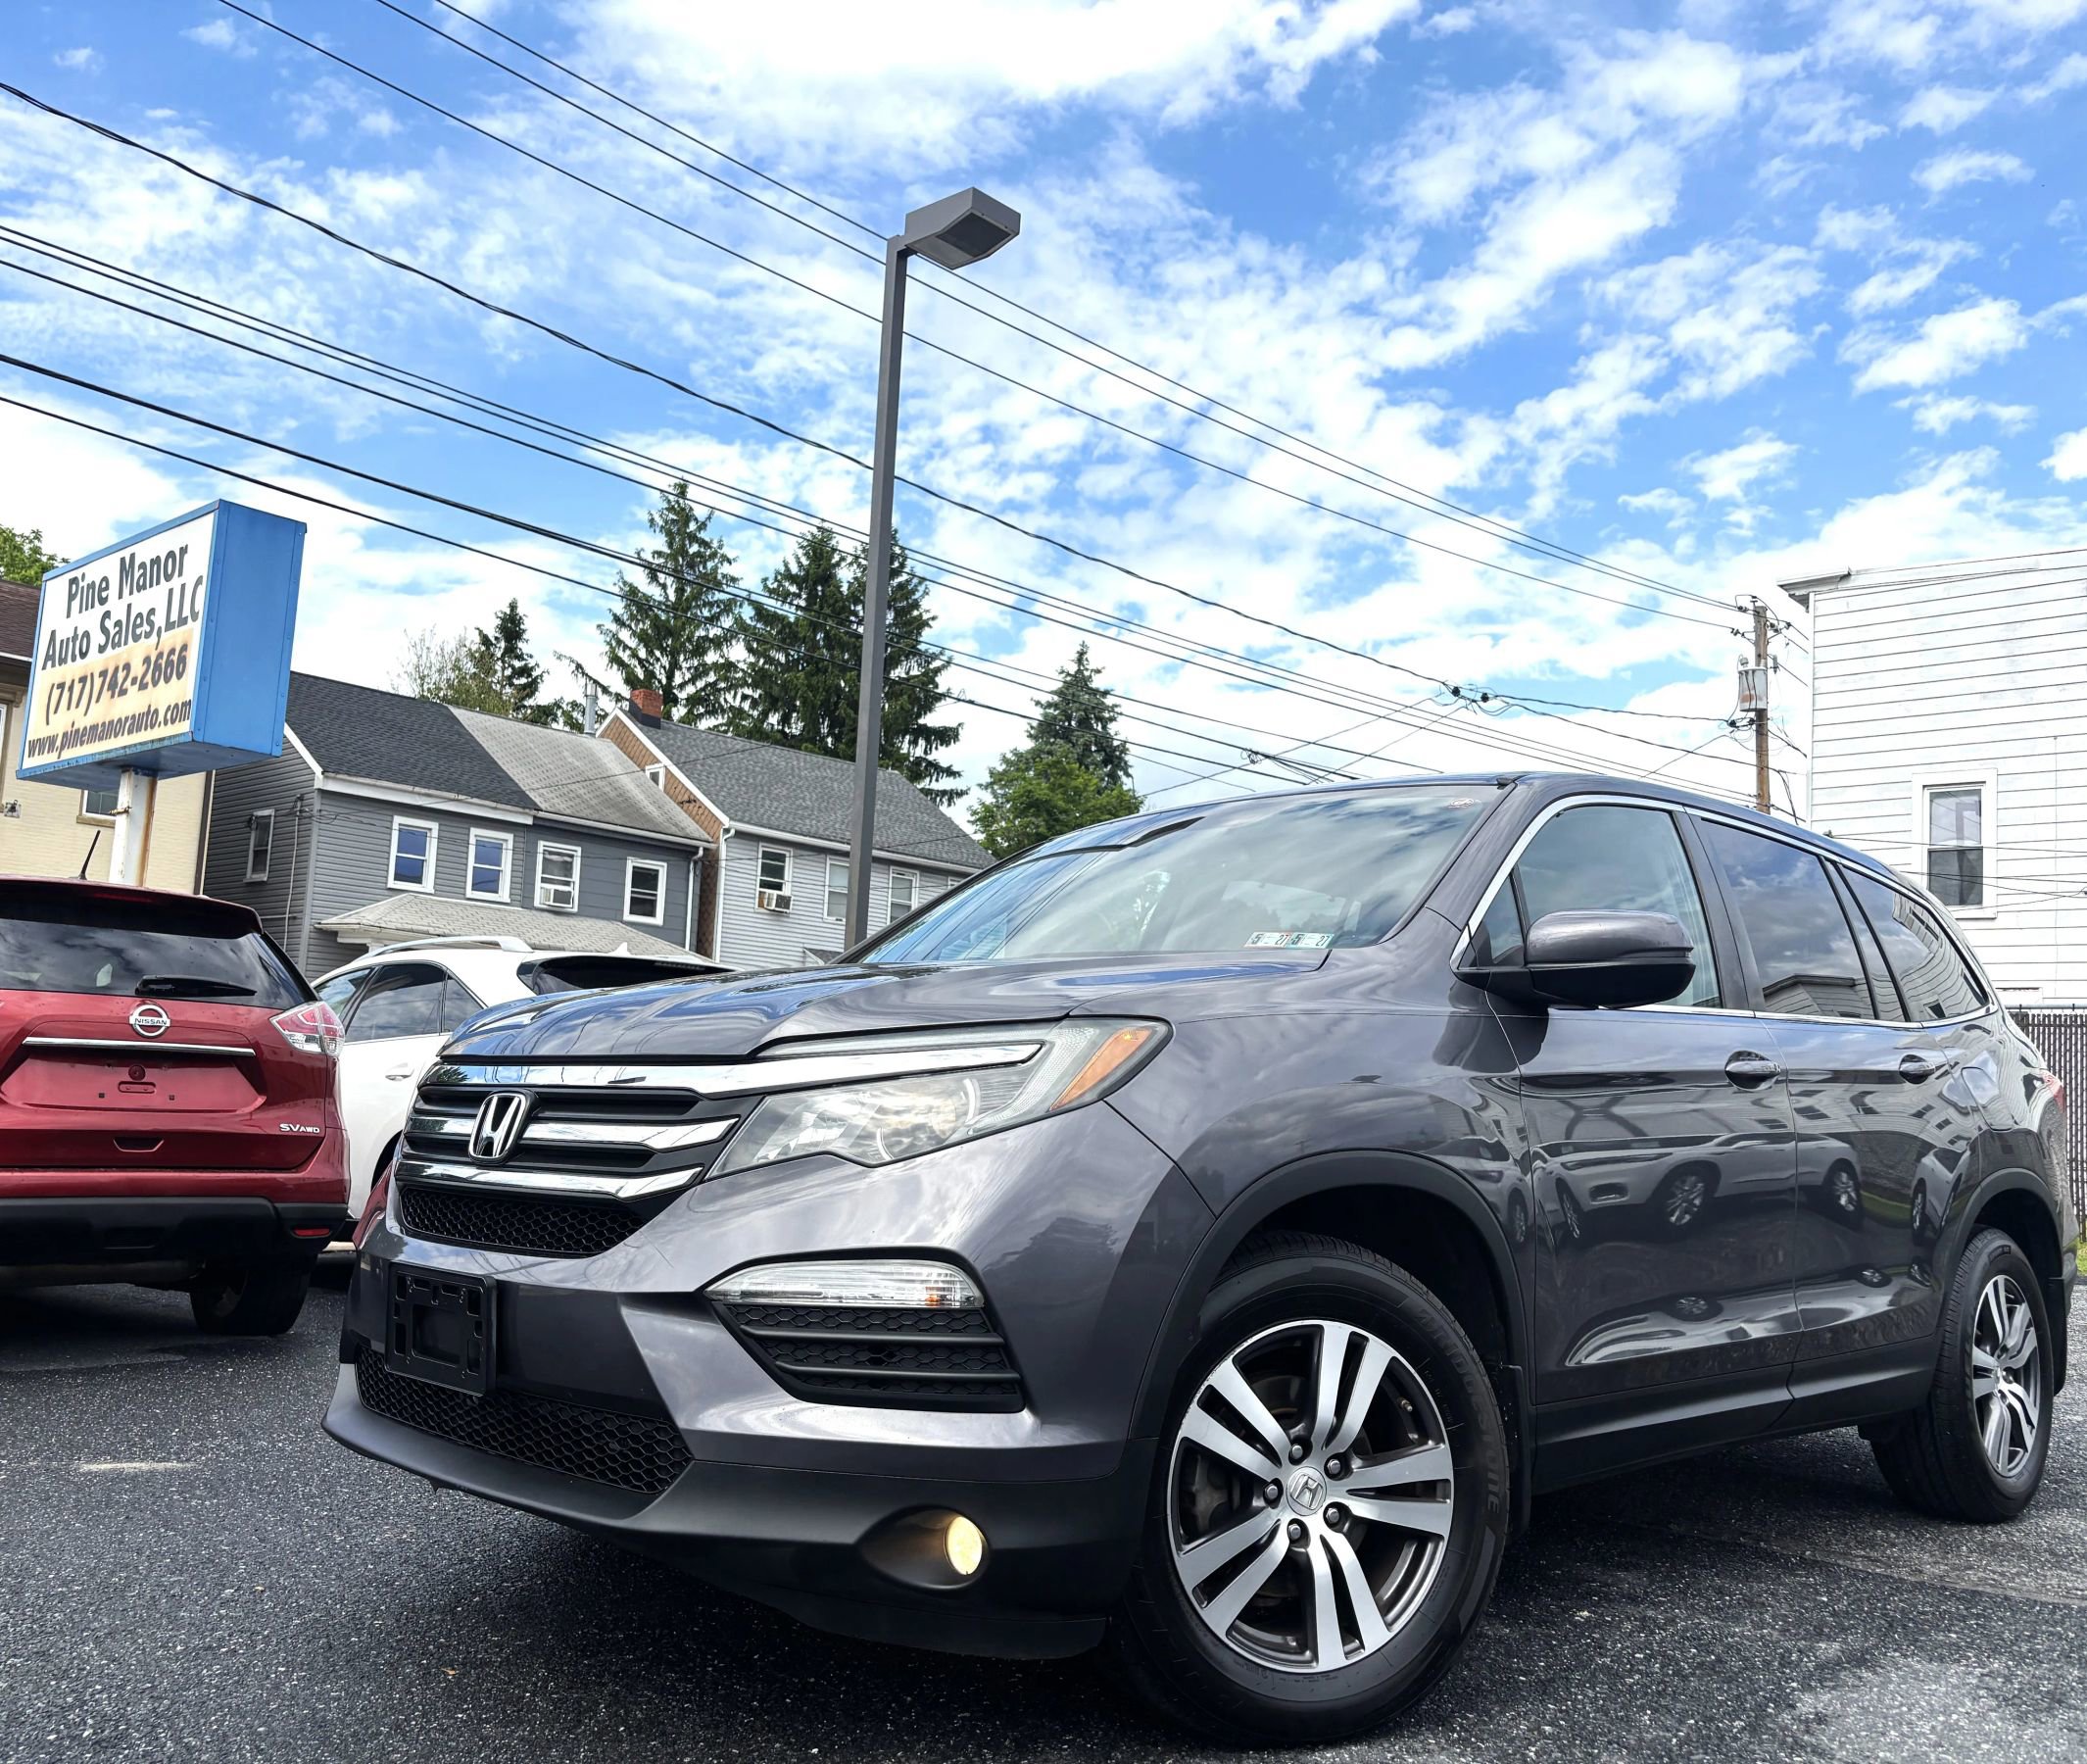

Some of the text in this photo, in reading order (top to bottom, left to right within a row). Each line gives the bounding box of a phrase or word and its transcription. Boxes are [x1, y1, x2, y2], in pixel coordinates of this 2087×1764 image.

[66, 544, 189, 619] Pine Manor
[41, 625, 91, 670] Auto
[27, 699, 192, 760] www.pinemanorauto.com
[1316, 935, 1330, 947] 27
